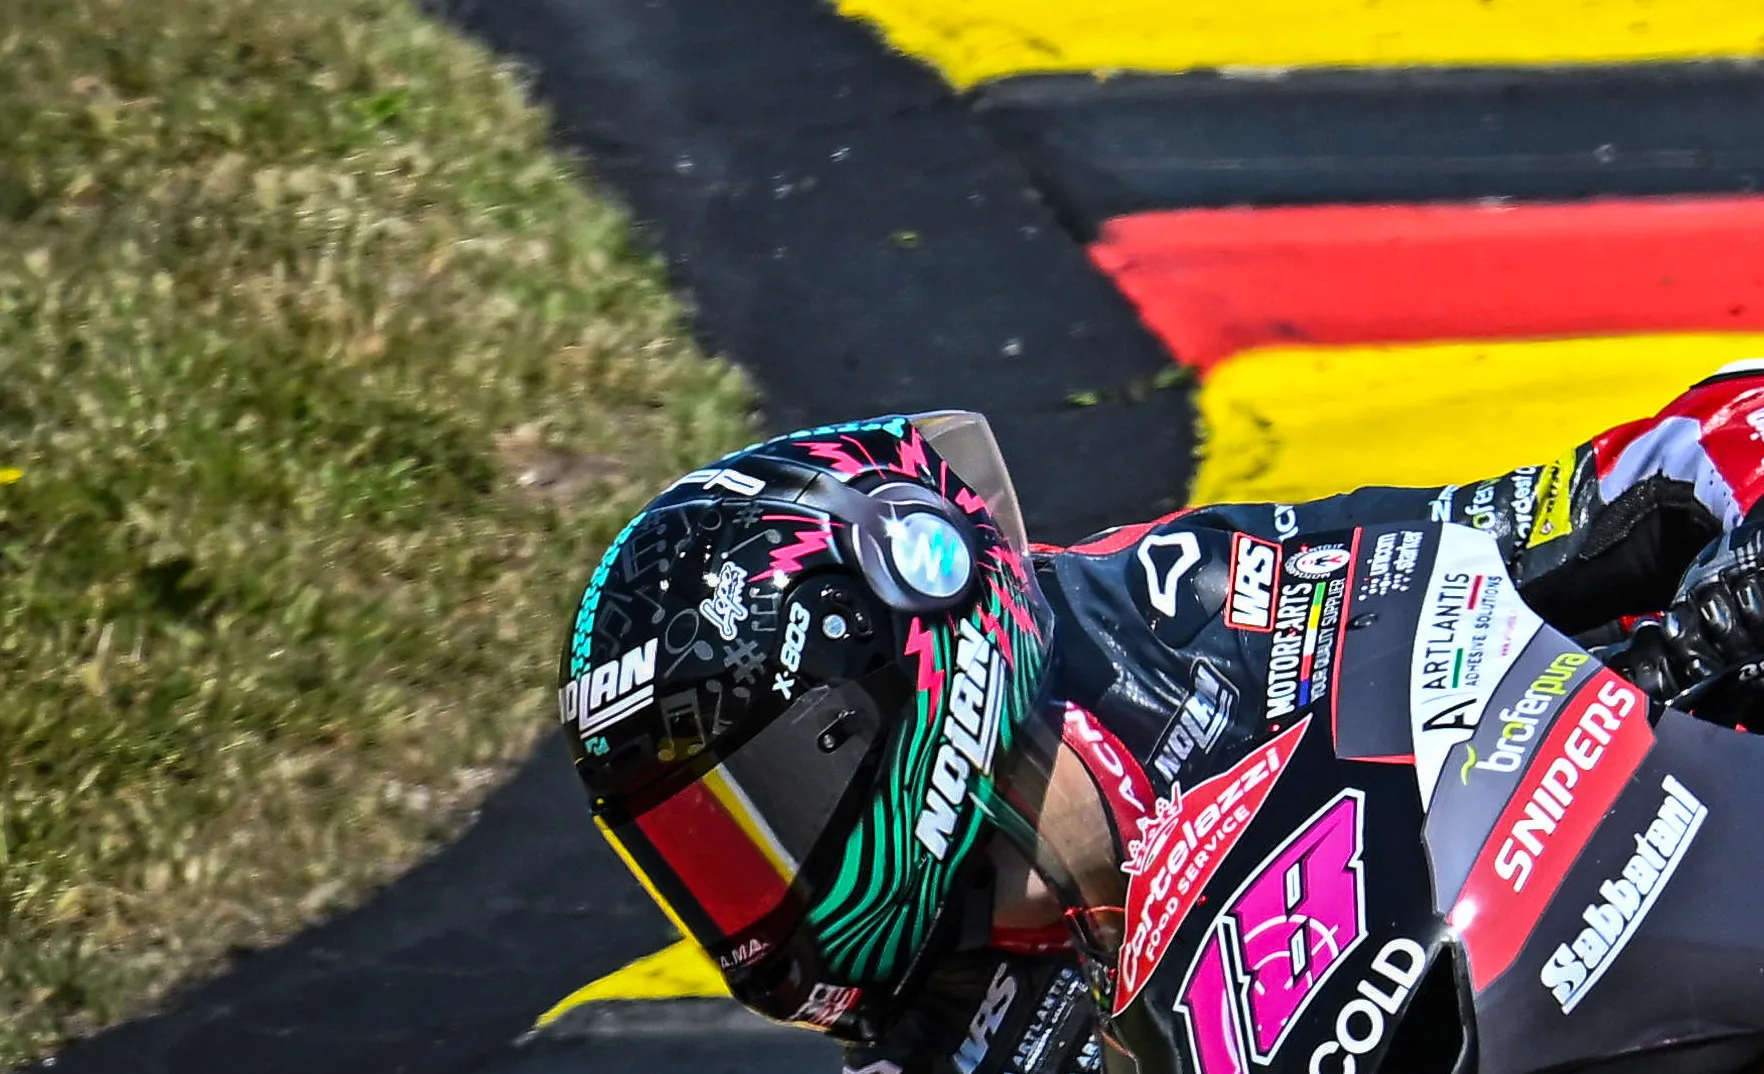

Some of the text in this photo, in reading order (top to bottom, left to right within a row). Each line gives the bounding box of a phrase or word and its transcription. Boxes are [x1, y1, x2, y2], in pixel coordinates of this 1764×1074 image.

[1230, 536, 1276, 629] WRS
[1321, 577, 1346, 627] SUPPLIER
[1422, 572, 1471, 690] ARTLANTIS
[1465, 574, 1504, 687] ADHESIVE SOLUTIONS
[915, 617, 1006, 862] NOLAN
[1494, 680, 1637, 893] SNIPERS
[1146, 807, 1251, 962] FOOD SERVICE
